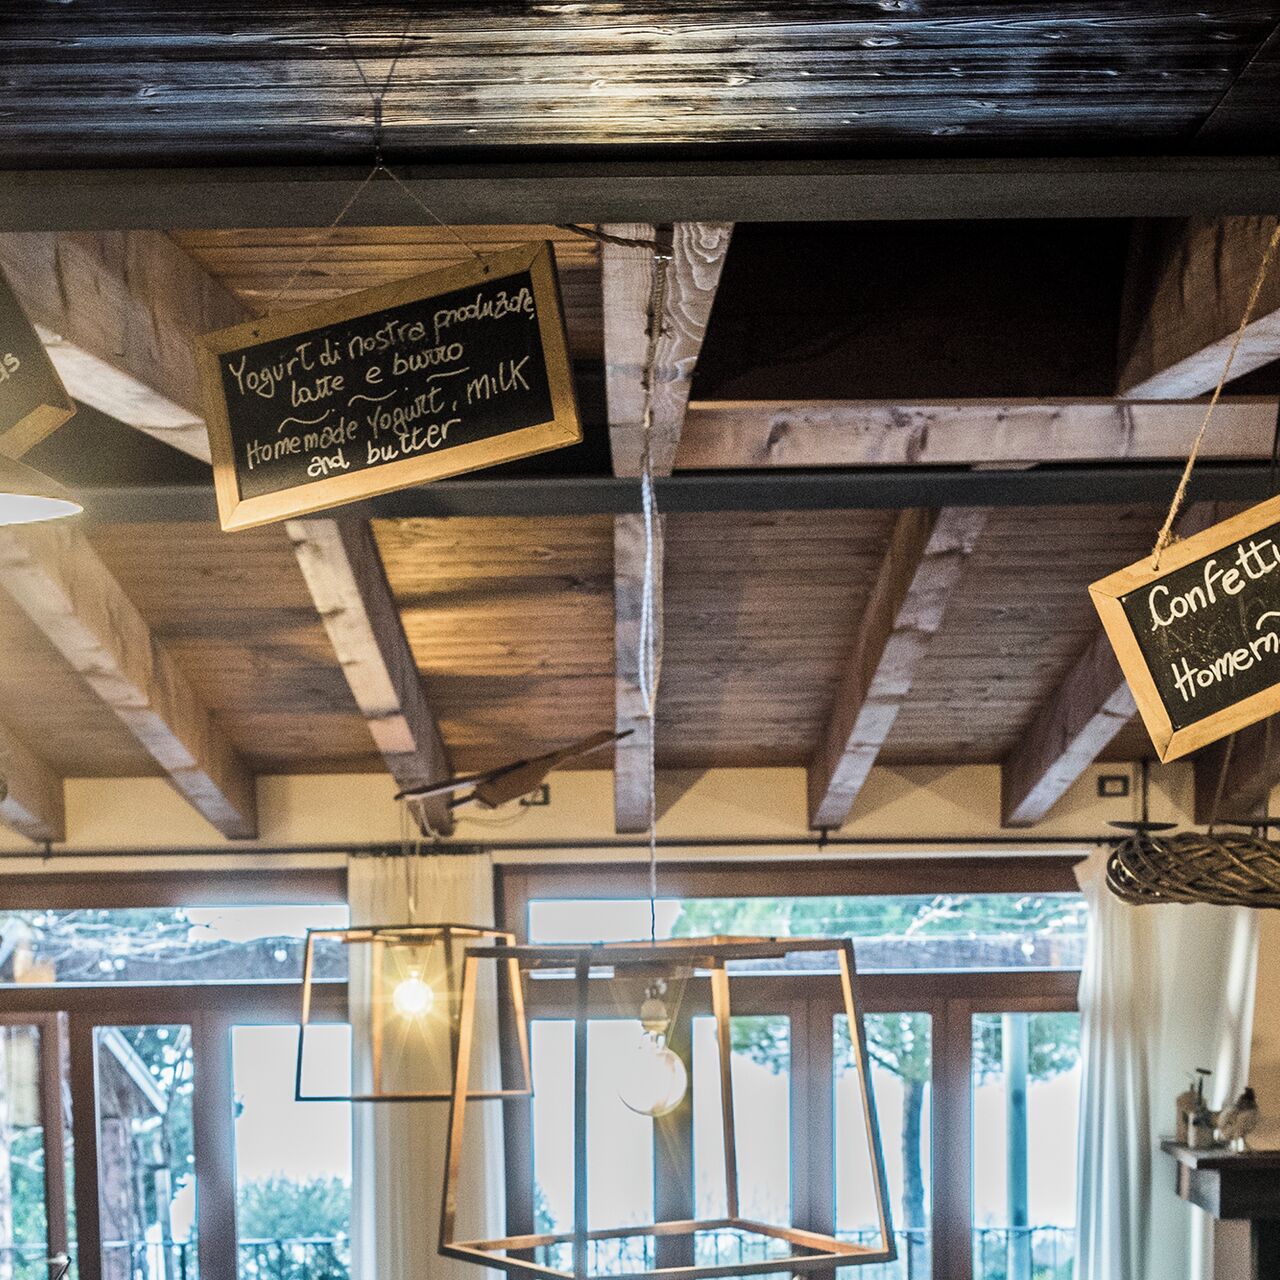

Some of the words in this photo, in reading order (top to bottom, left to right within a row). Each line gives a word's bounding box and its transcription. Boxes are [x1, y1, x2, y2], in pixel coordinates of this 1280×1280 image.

[228, 340, 315, 398] Yogurt
[319, 337, 341, 367] di
[347, 320, 426, 360] nostra
[365, 365, 383, 384] e
[392, 342, 464, 376] burro
[246, 416, 359, 469] Homemade
[306, 449, 351, 477] and
[366, 418, 462, 466] butter
